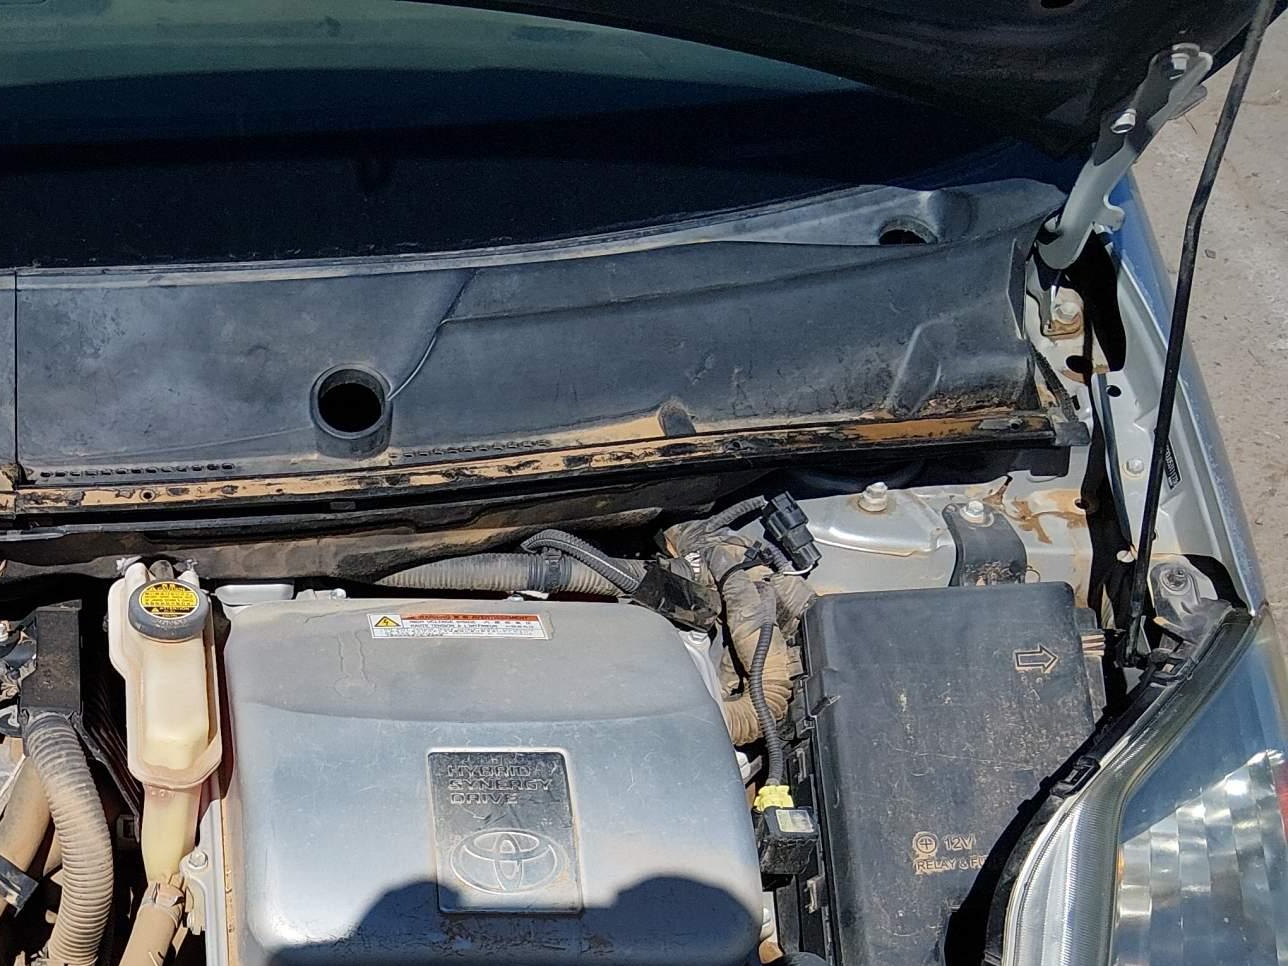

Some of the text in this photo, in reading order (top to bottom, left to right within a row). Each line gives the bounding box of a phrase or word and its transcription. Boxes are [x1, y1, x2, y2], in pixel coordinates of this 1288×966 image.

[447, 765, 531, 777] HYBRID
[448, 779, 552, 790] SYNERGY
[450, 793, 521, 804] DRIVE
[915, 857, 957, 871] RELAY
[959, 857, 969, 869] &
